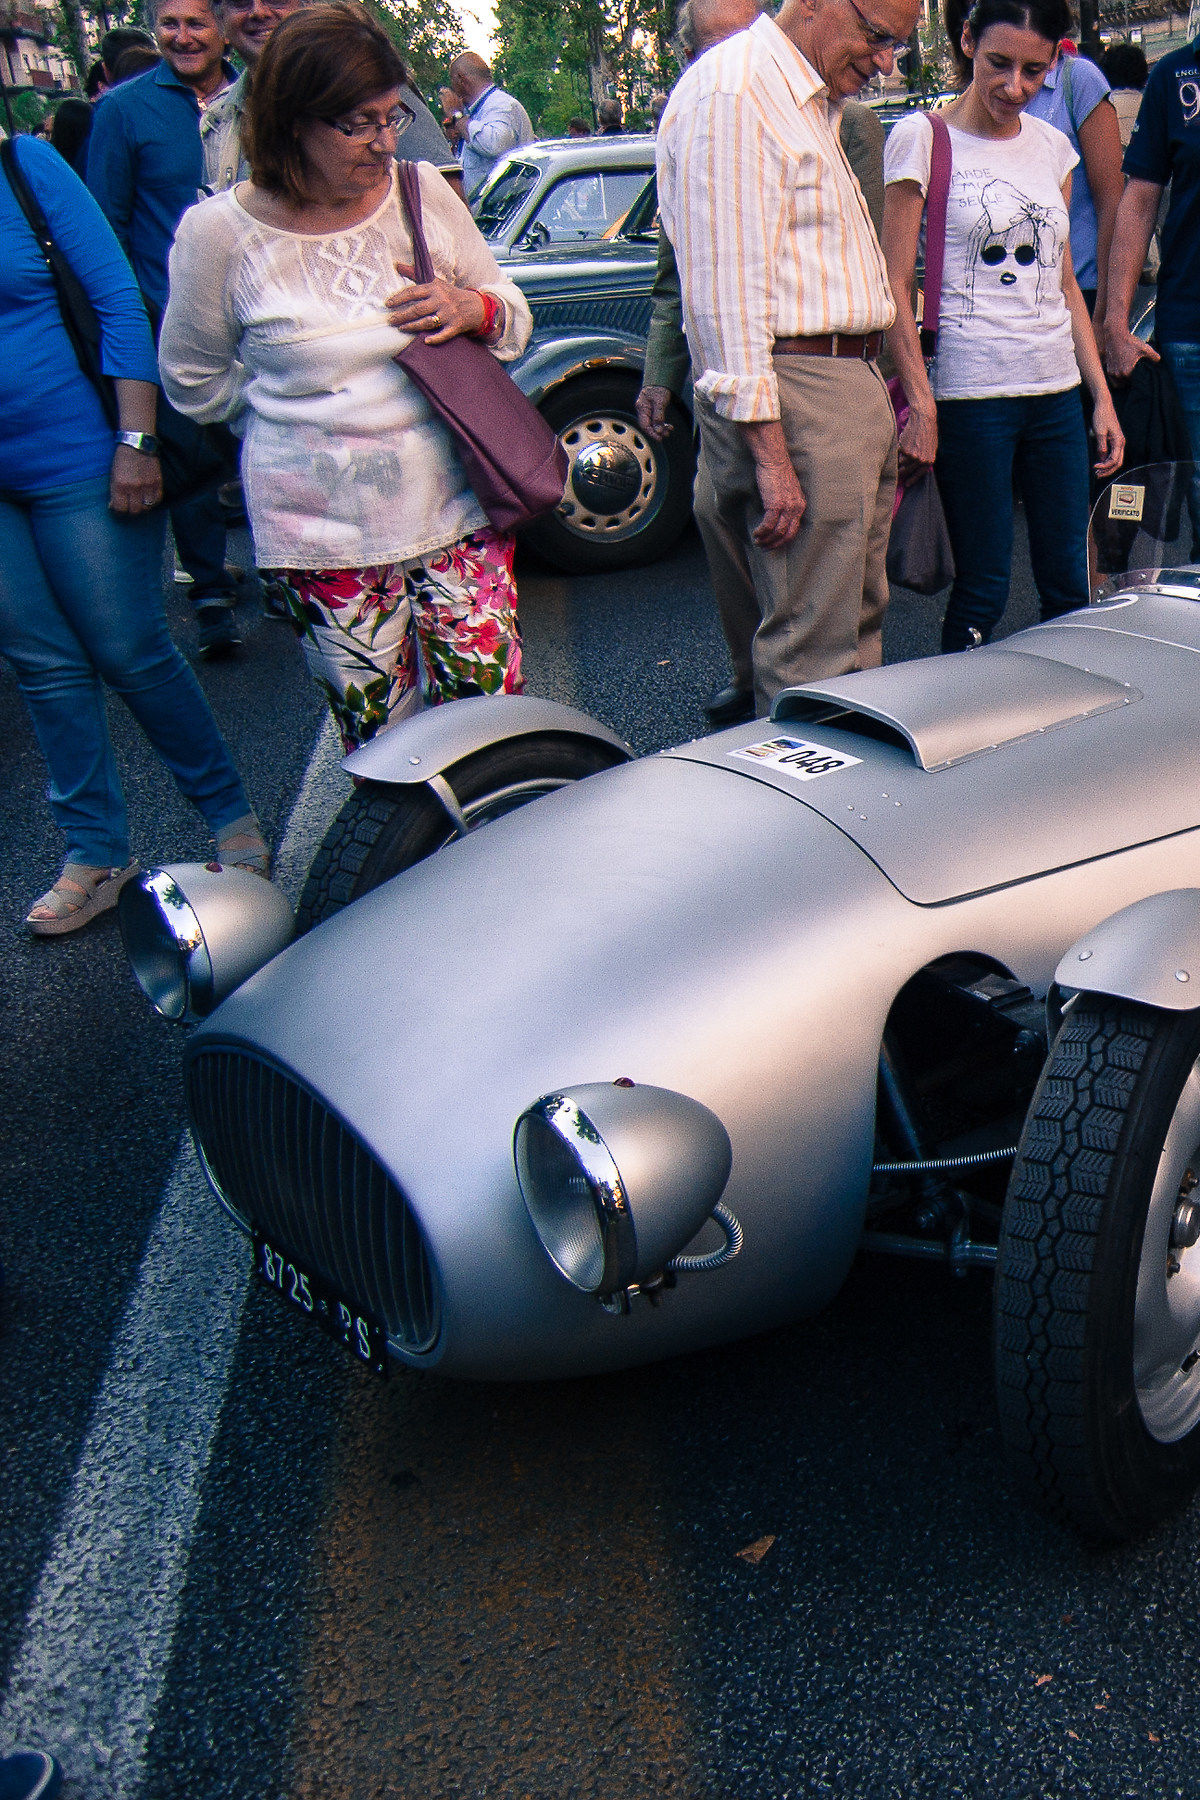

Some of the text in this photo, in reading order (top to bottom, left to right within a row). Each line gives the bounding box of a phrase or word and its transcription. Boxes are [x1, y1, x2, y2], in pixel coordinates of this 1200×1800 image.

[1111, 508, 1140, 517] VERIFICATO
[778, 750, 845, 774] 048
[263, 1243, 314, 1312] 8725
